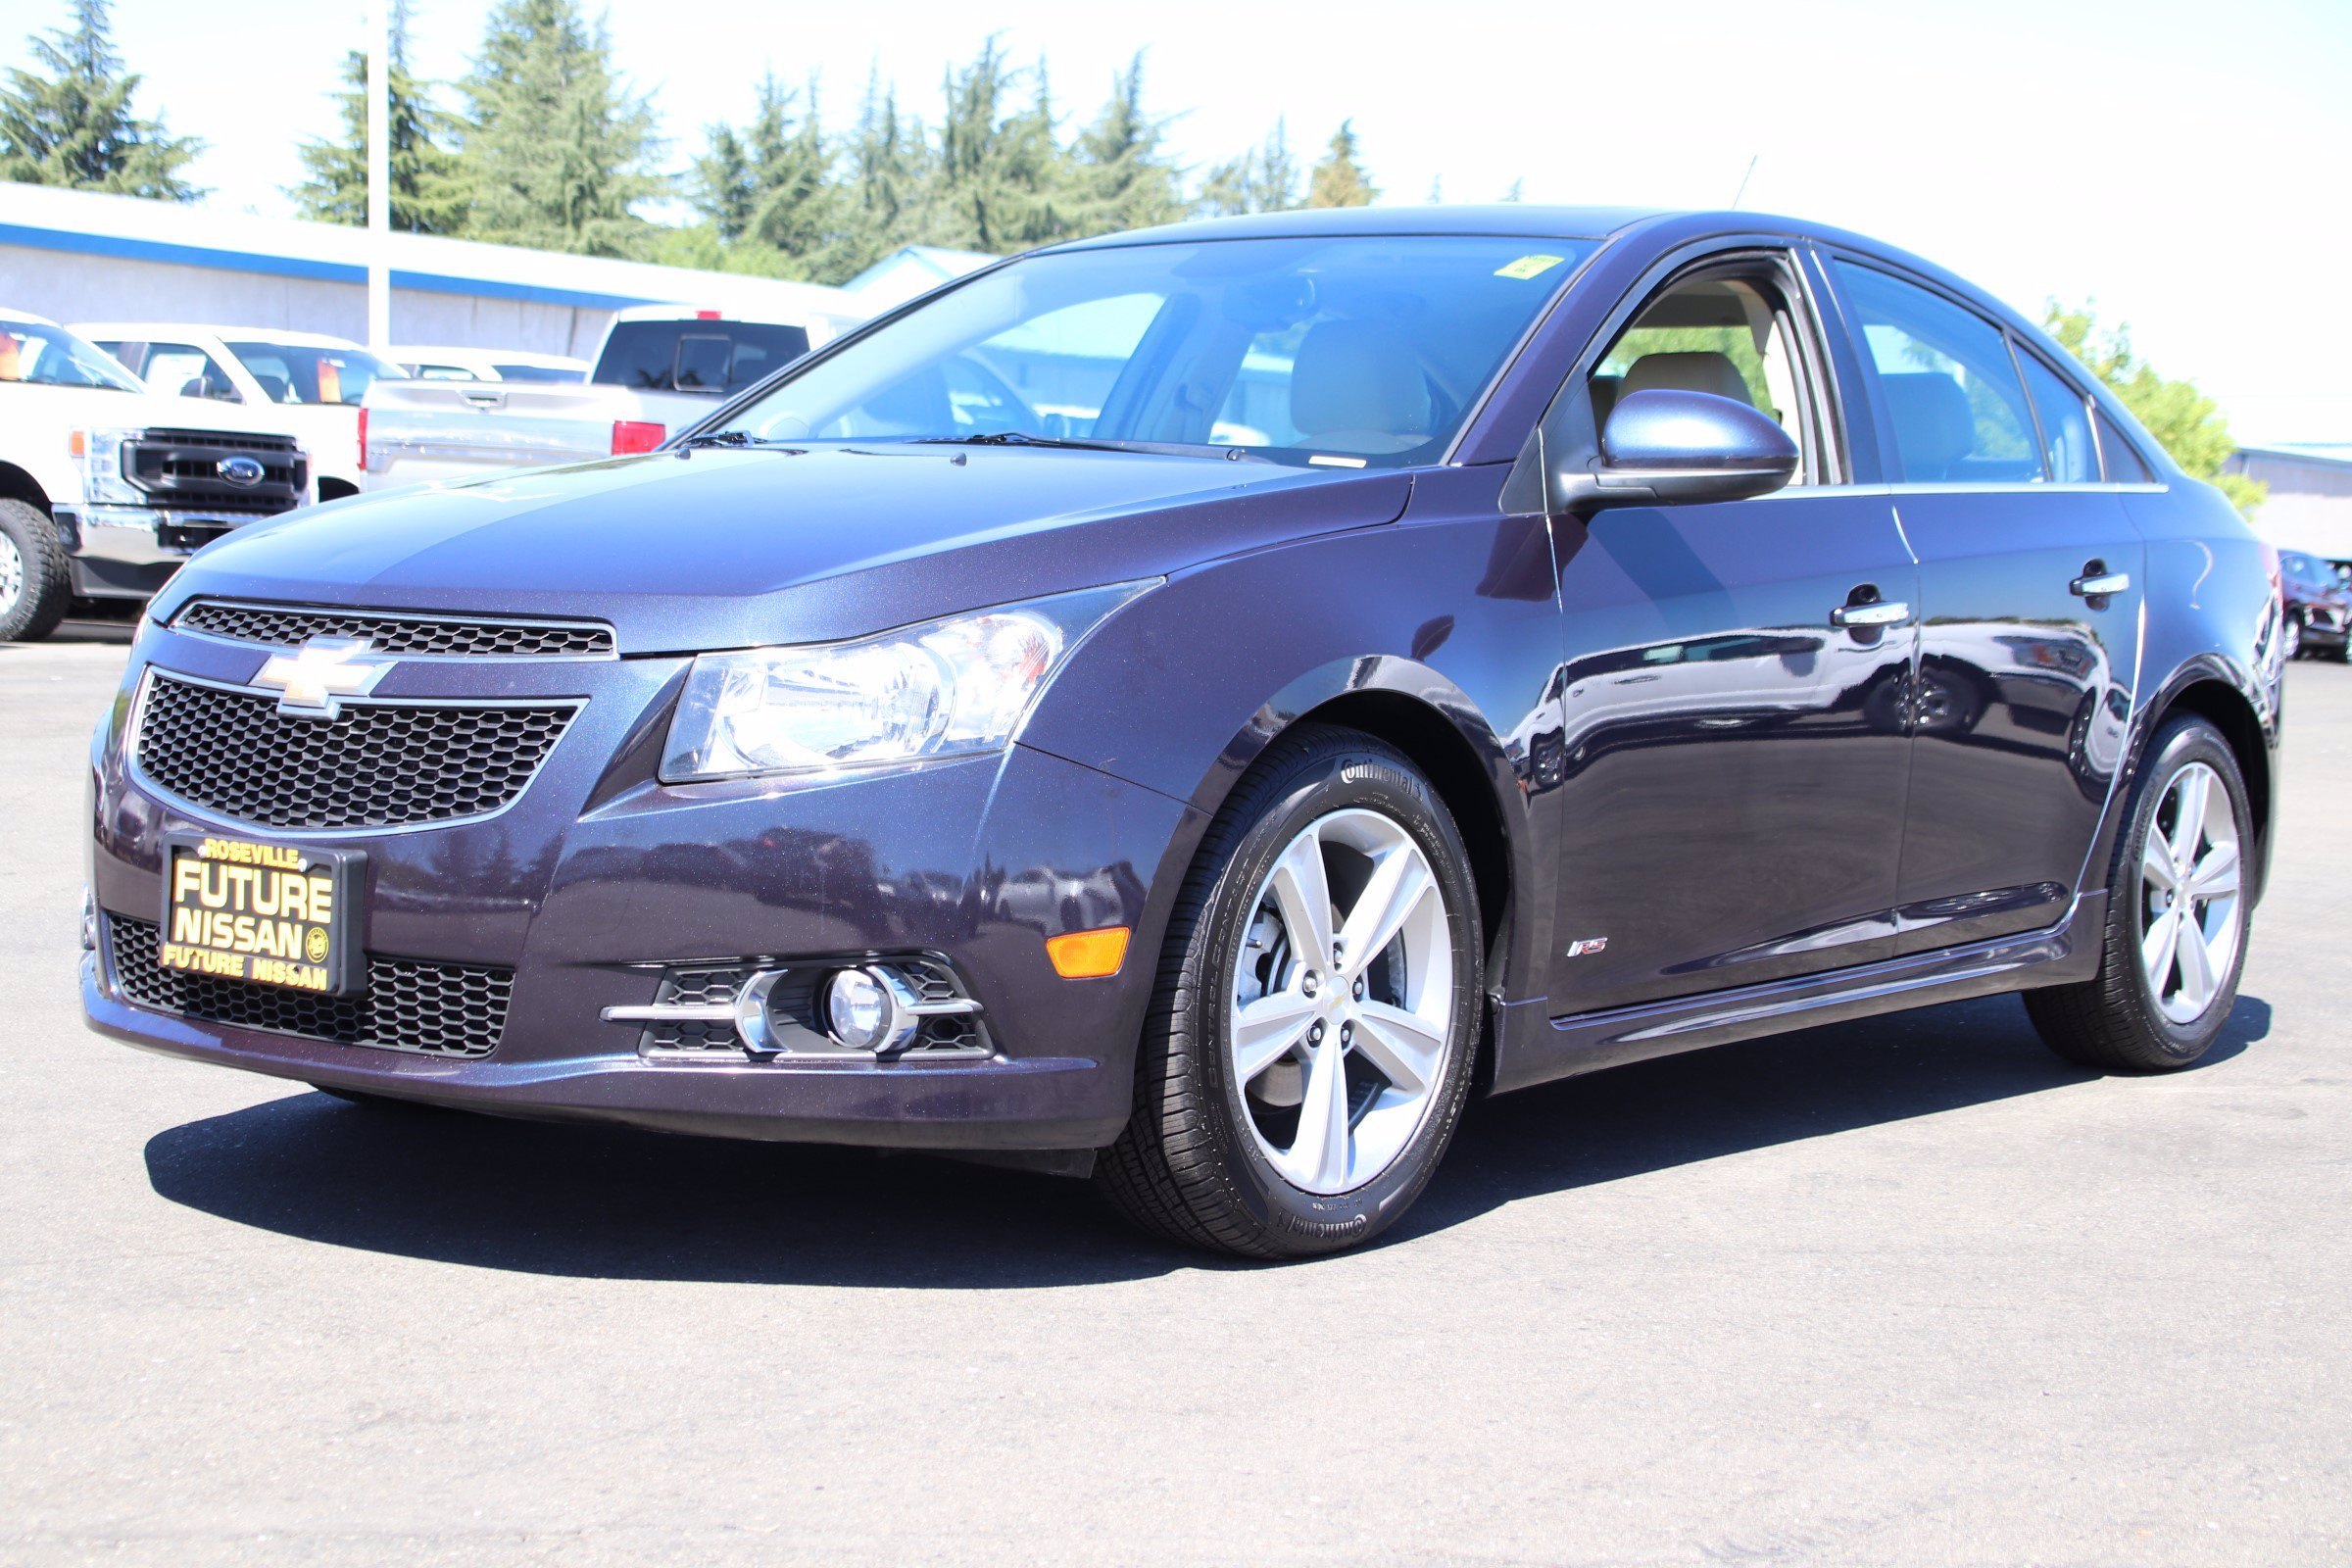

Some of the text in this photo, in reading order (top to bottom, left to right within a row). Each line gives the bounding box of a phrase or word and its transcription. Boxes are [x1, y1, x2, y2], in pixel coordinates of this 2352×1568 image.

[1341, 760, 1413, 795] Continental
[204, 838, 299, 869] ROSEVILLE
[174, 858, 333, 923] FUTURE
[174, 907, 303, 960] NISSAN
[163, 944, 327, 991] FUTURE NISSAN
